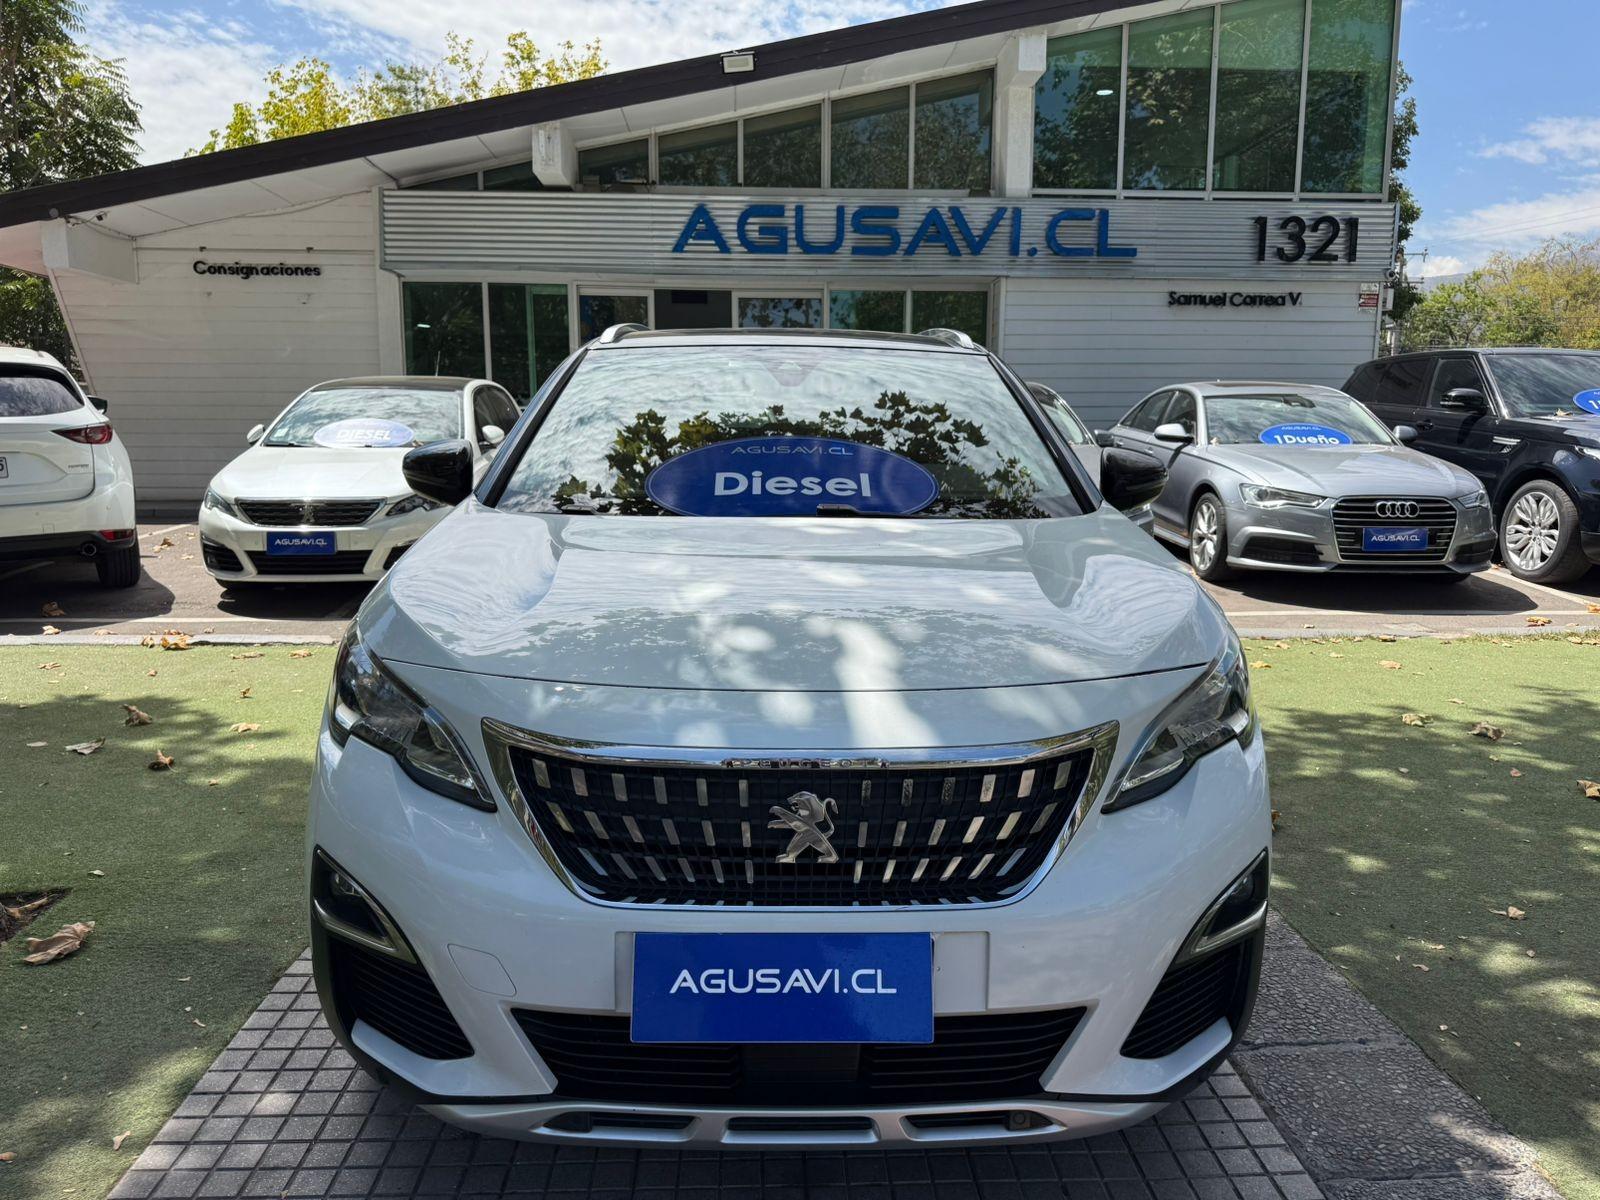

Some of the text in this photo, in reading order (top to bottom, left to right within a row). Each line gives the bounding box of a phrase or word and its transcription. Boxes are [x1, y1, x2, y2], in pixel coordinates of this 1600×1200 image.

[672, 203, 1138, 257] AGUSAVI.CL
[1253, 215, 1360, 262] 1321
[193, 260, 322, 280] Consignaciones
[1168, 291, 1227, 307] Samuel
[1229, 292, 1286, 307] Correa
[337, 429, 392, 441] DIESEL
[731, 445, 854, 456] AGUSAVI.CL
[714, 470, 872, 498] Diesel
[274, 538, 328, 546] AGUSAVI.CL
[1371, 534, 1420, 542] AGUSAVI.CL
[669, 968, 898, 994] AGUSAVI.CL
